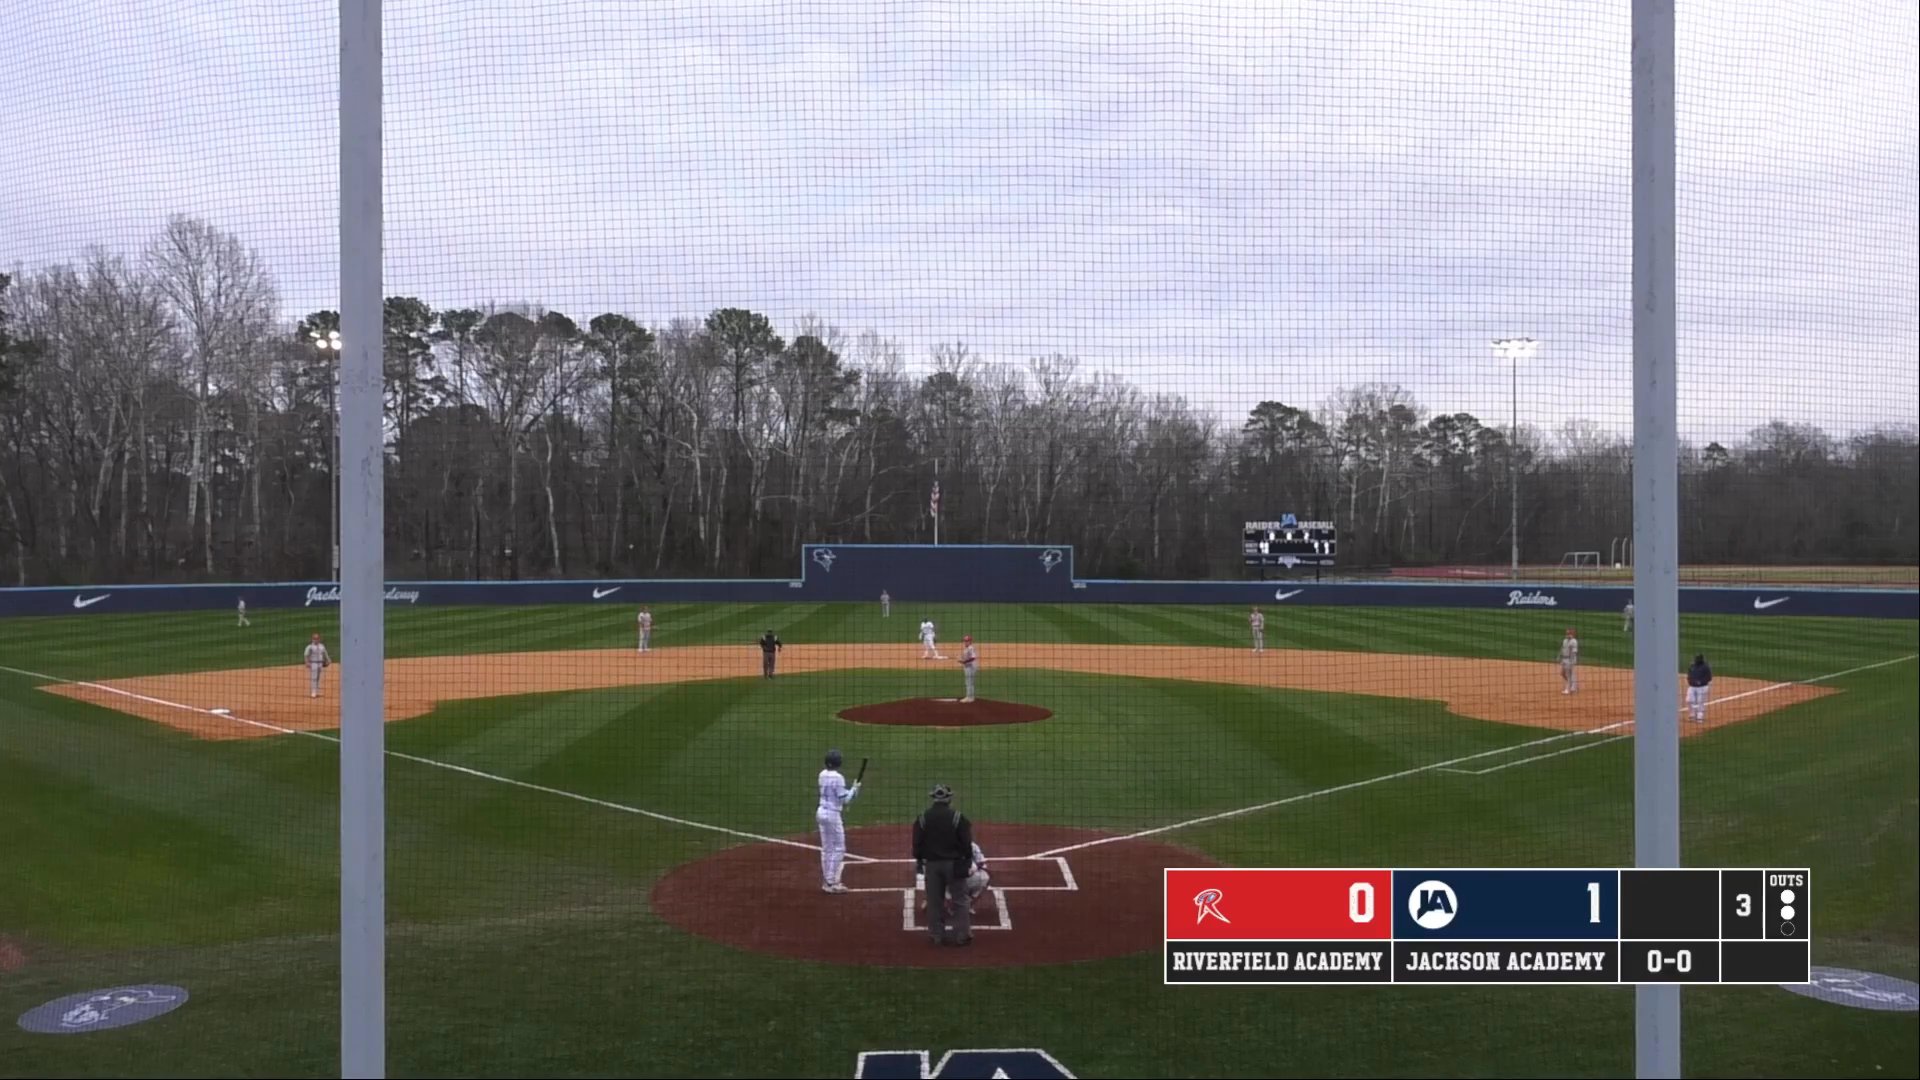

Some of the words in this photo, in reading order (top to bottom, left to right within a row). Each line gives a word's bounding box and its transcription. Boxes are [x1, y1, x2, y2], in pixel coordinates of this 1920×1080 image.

[1245, 521, 1280, 529] RAIDER
[1297, 521, 1335, 529] BASEBALL
[1506, 590, 1557, 606] Raiders
